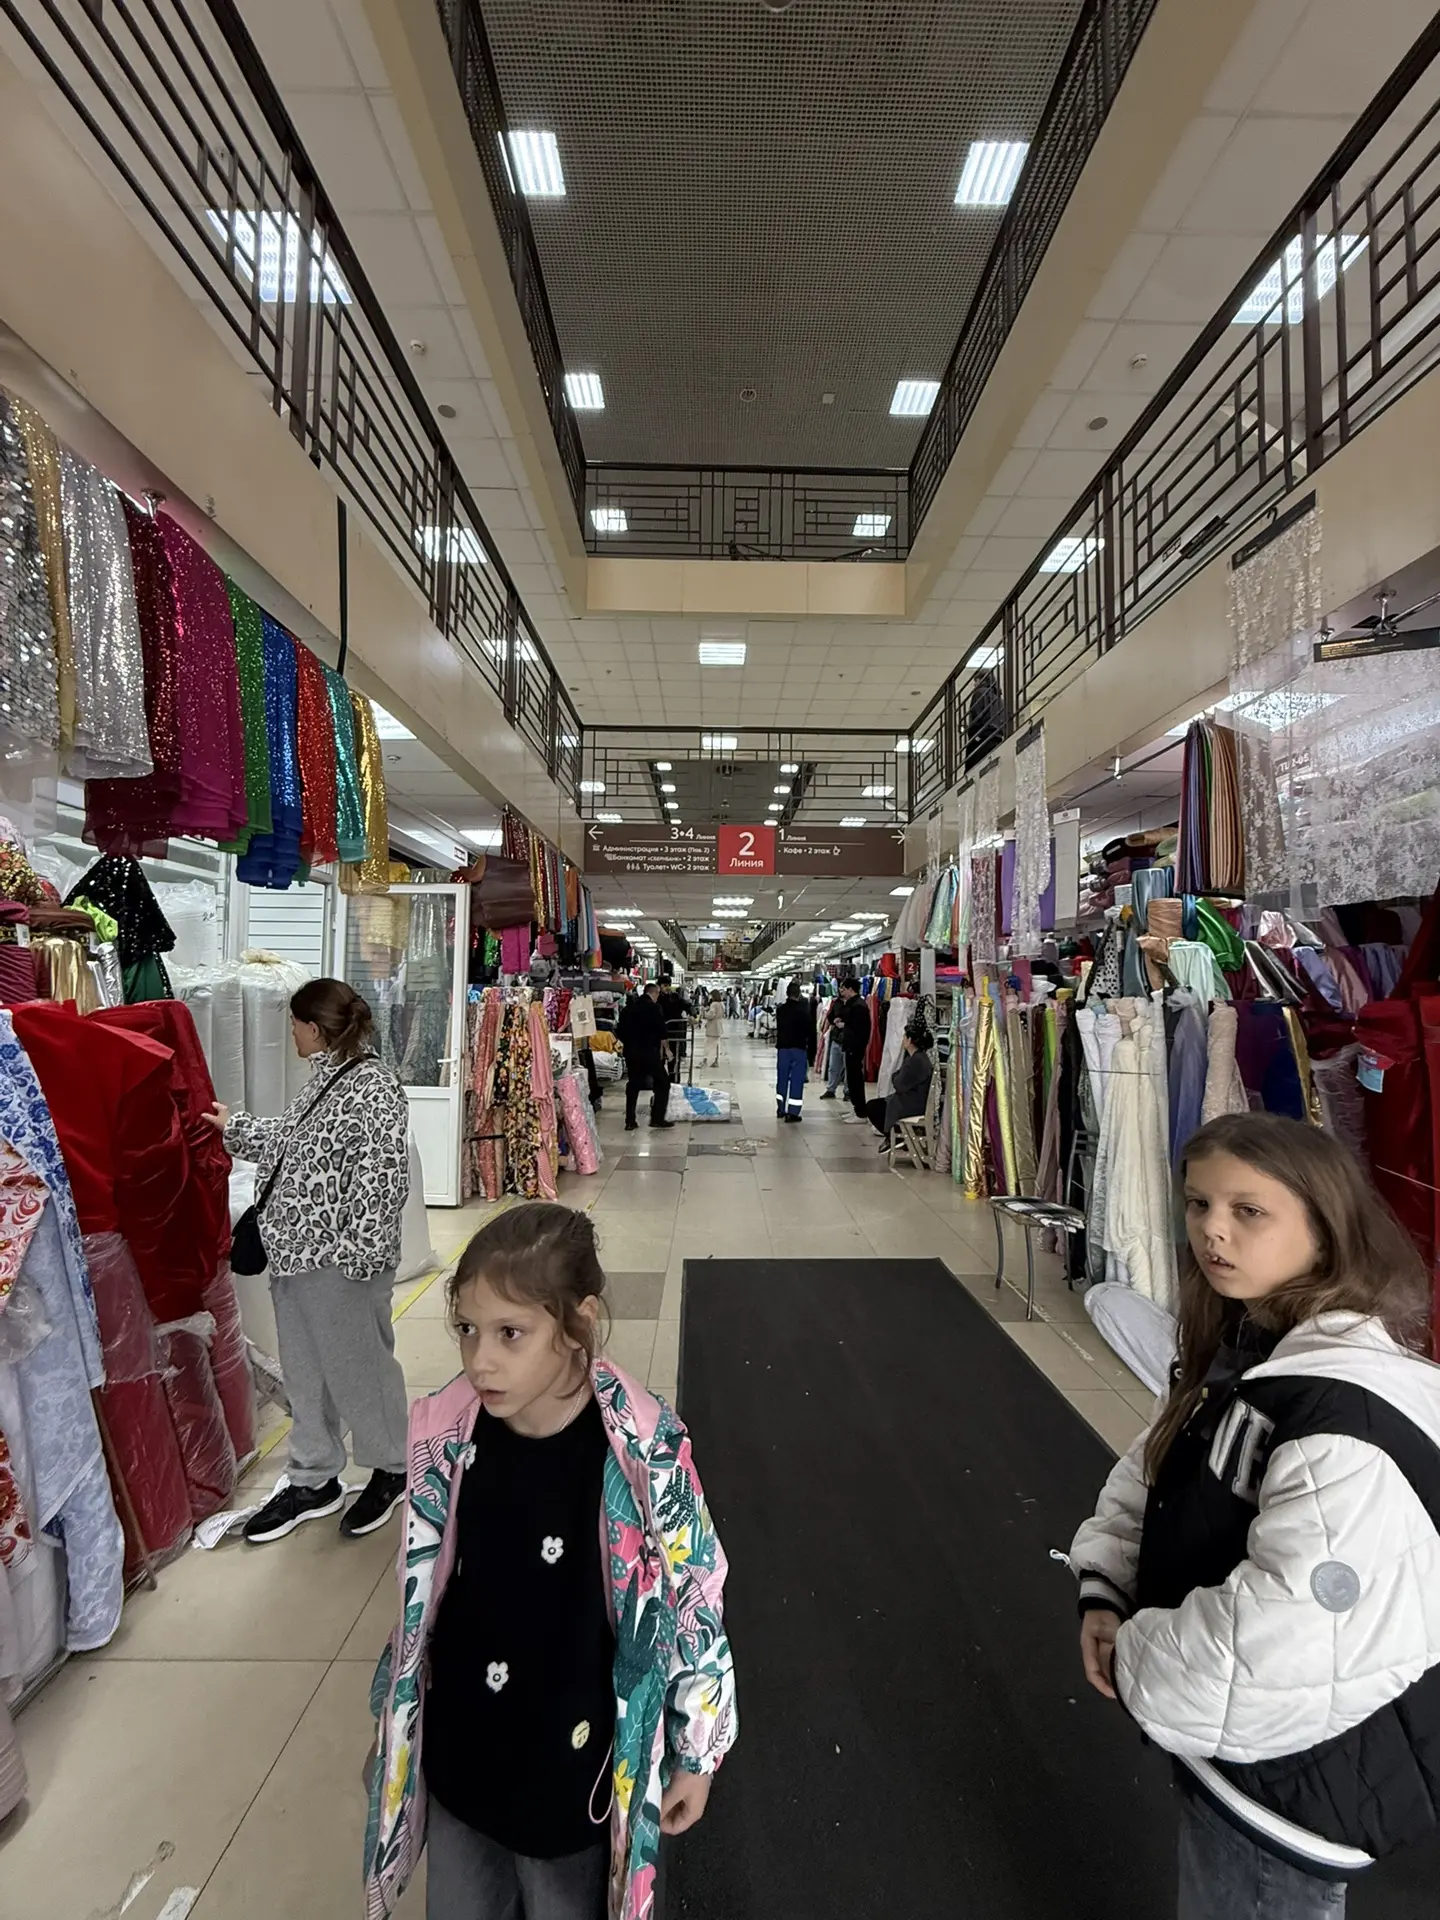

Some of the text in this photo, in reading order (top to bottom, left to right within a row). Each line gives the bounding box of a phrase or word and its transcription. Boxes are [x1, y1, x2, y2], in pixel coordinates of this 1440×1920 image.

[778, 828, 785, 841] 1
[602, 845, 659, 853] Администрация
[739, 832, 755, 856] 2
[783, 847, 802, 855] Кафе
[729, 857, 764, 868] Линия
[908, 962, 914, 971] 2
